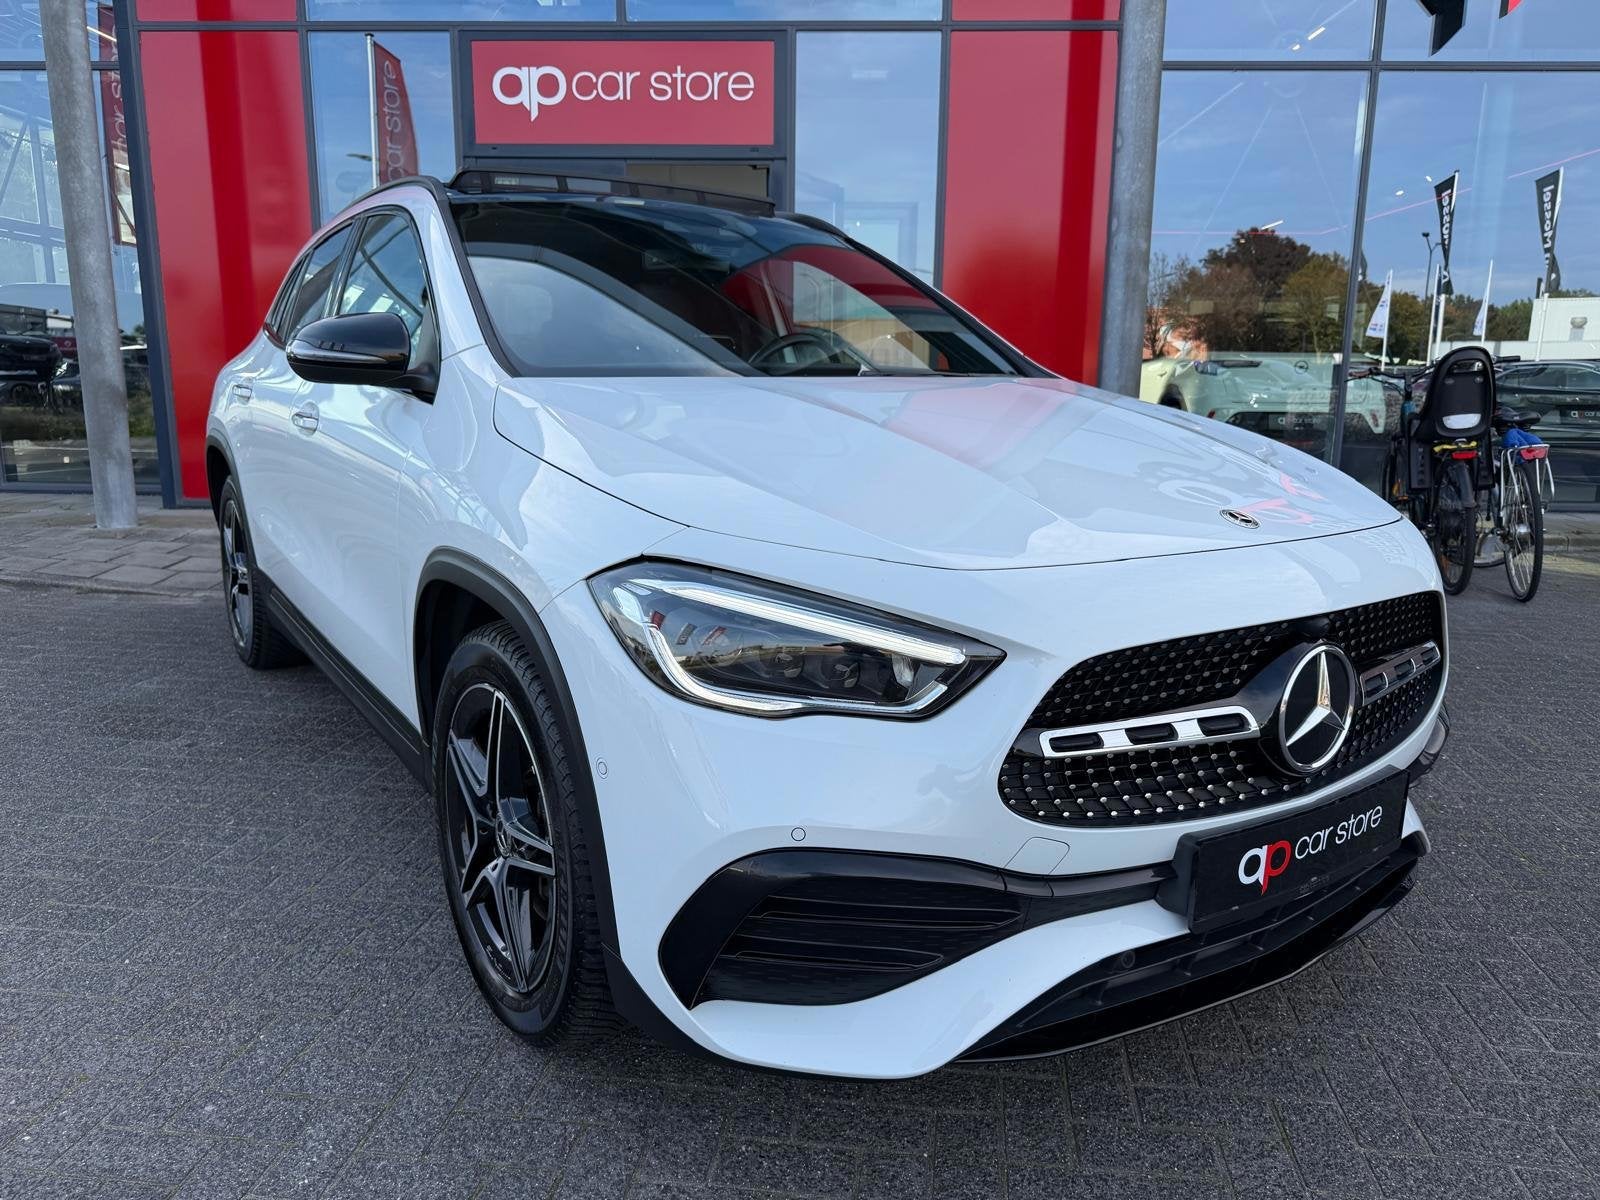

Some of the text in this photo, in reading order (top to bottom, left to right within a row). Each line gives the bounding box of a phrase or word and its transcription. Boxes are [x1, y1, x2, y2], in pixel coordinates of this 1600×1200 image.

[383, 60, 401, 133] store
[572, 71, 640, 101] car
[650, 65, 755, 101] store
[1295, 827, 1333, 860] car
[1335, 805, 1383, 844] store
